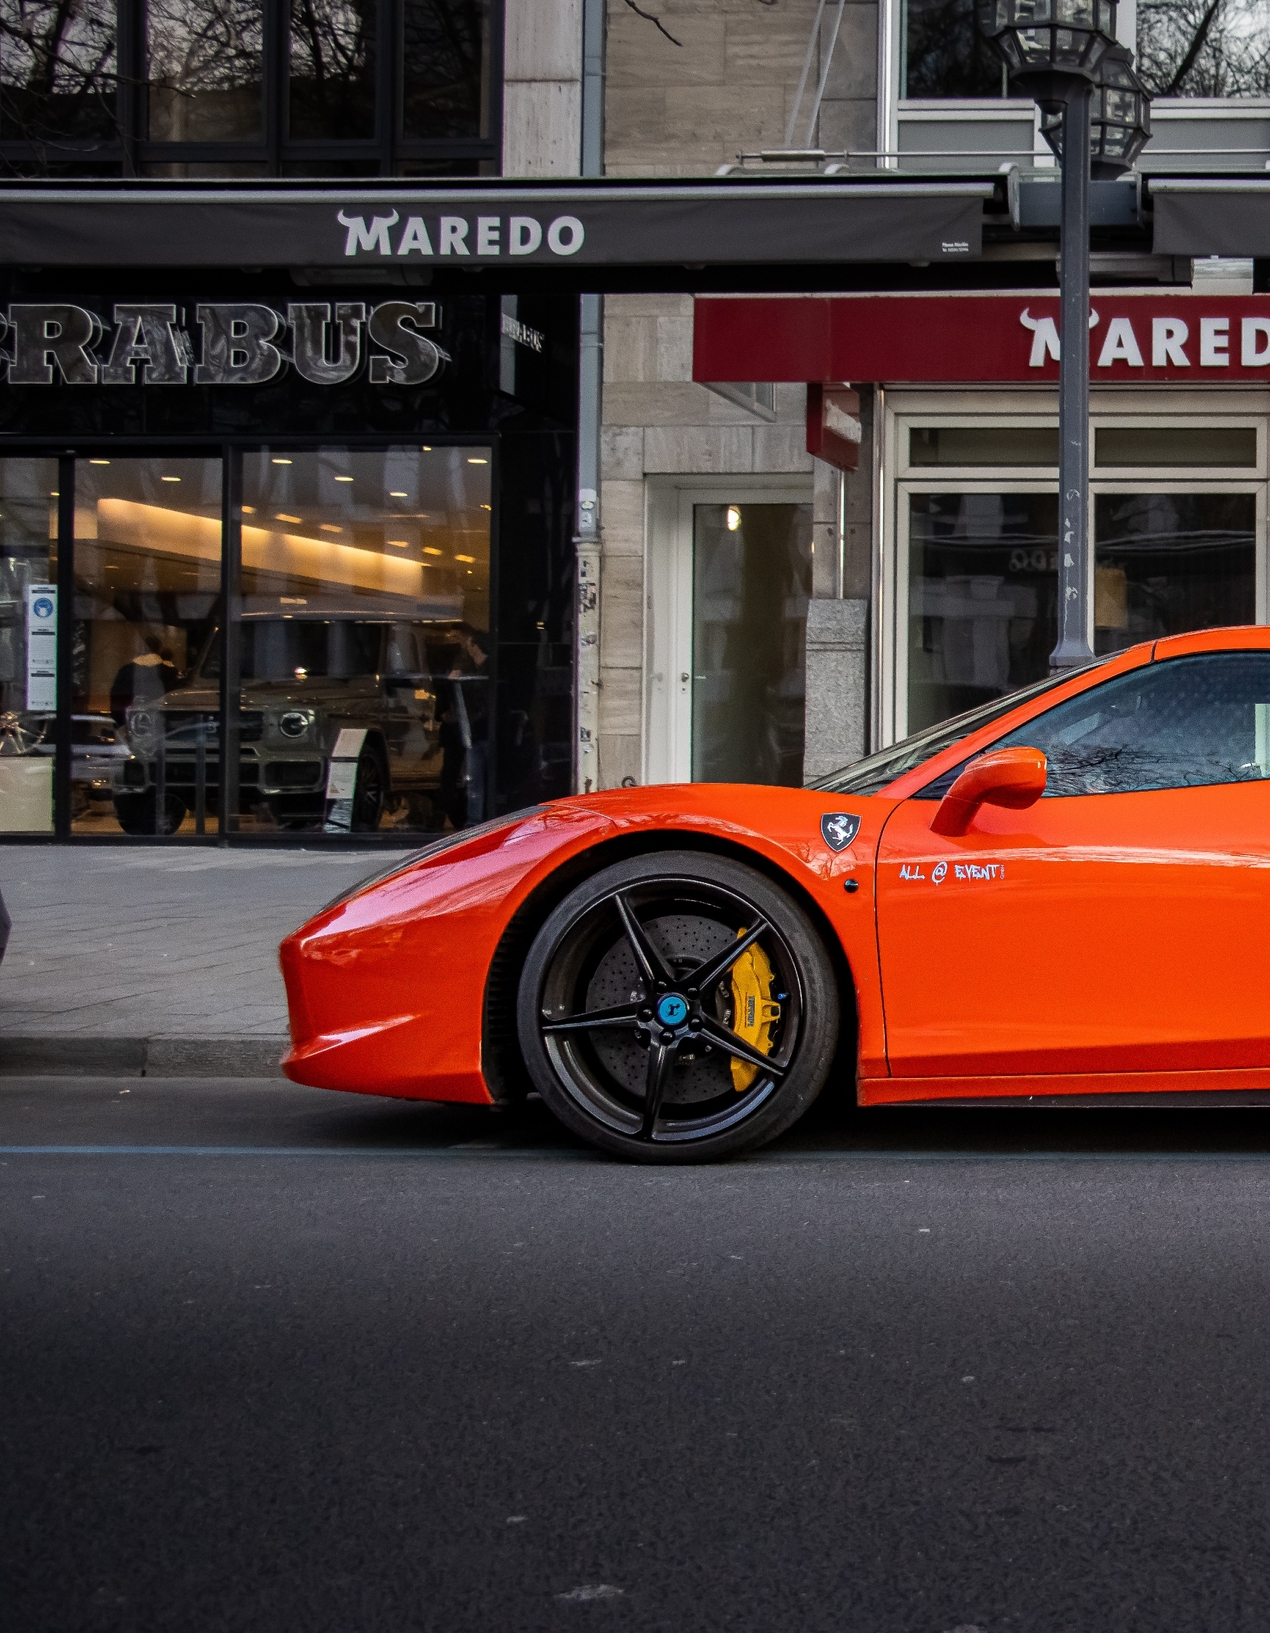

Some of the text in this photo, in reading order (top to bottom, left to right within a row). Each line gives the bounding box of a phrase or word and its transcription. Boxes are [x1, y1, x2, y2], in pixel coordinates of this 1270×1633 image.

[337, 208, 585, 256] MAREDO
[0, 302, 439, 385] RABUS
[899, 864, 925, 880] ALL
[955, 864, 999, 882] EVENT
